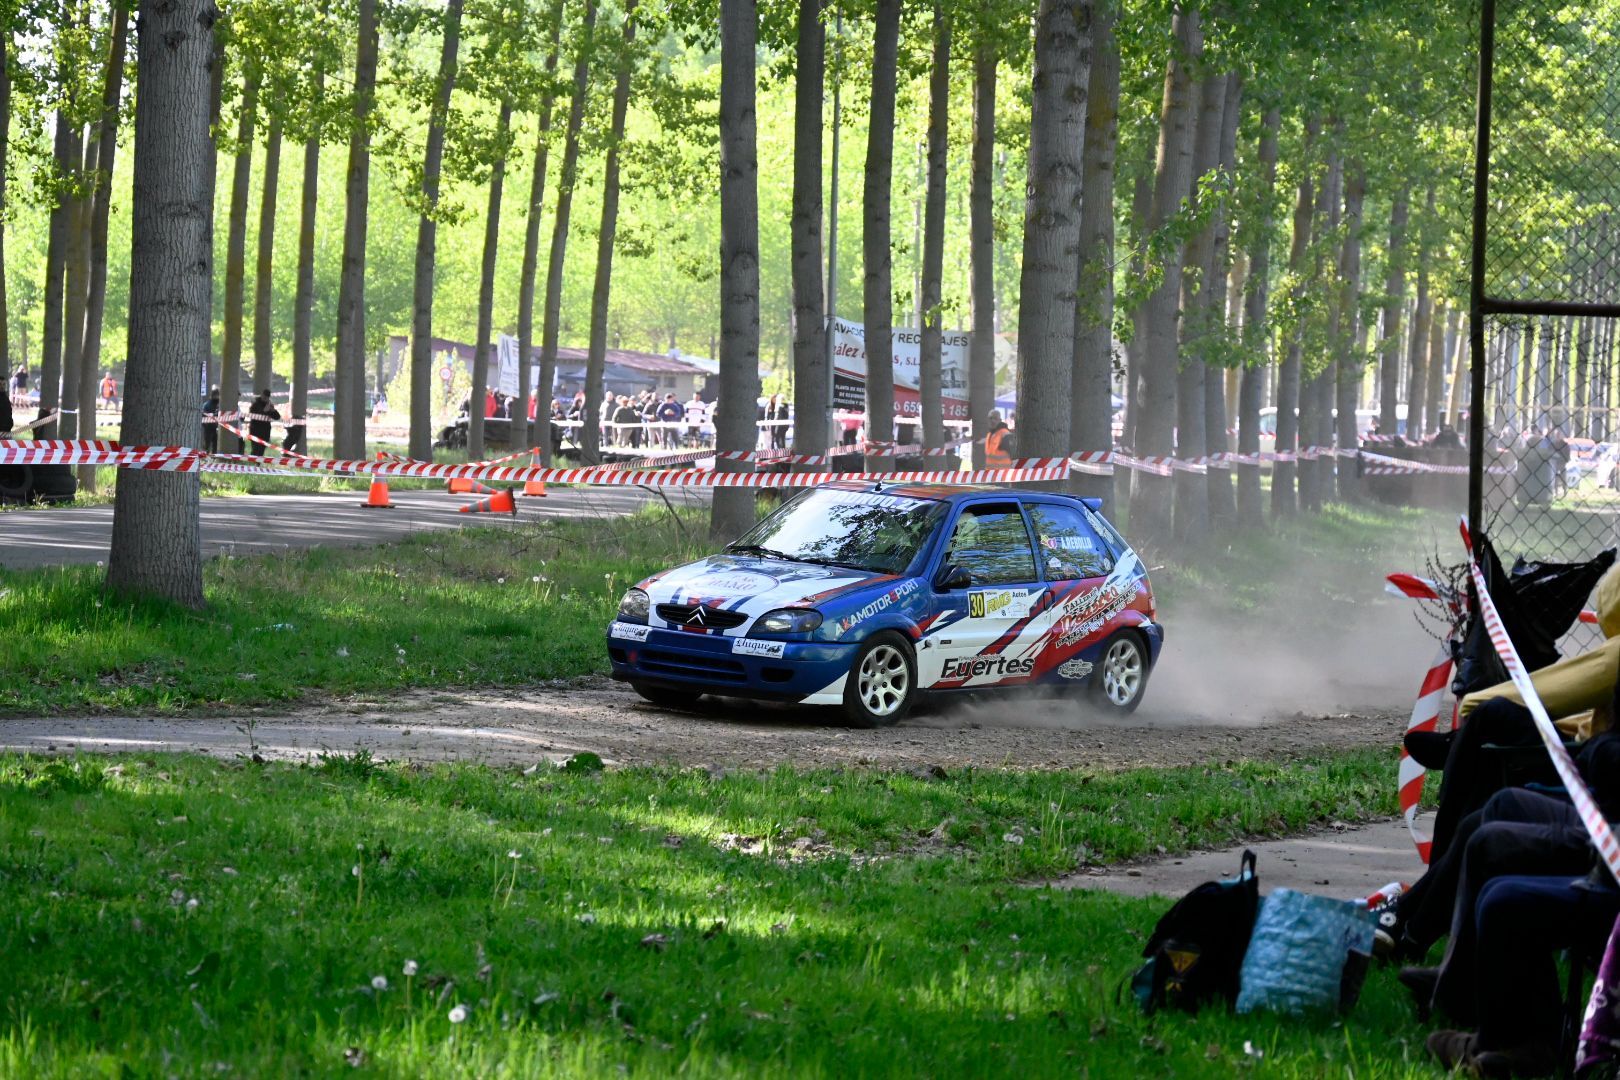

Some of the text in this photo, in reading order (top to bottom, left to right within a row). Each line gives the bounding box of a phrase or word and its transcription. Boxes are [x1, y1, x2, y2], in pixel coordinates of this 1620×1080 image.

[898, 332, 969, 348] RECAJES
[970, 593, 984, 617] 30
[940, 655, 1035, 679] Fuertes
